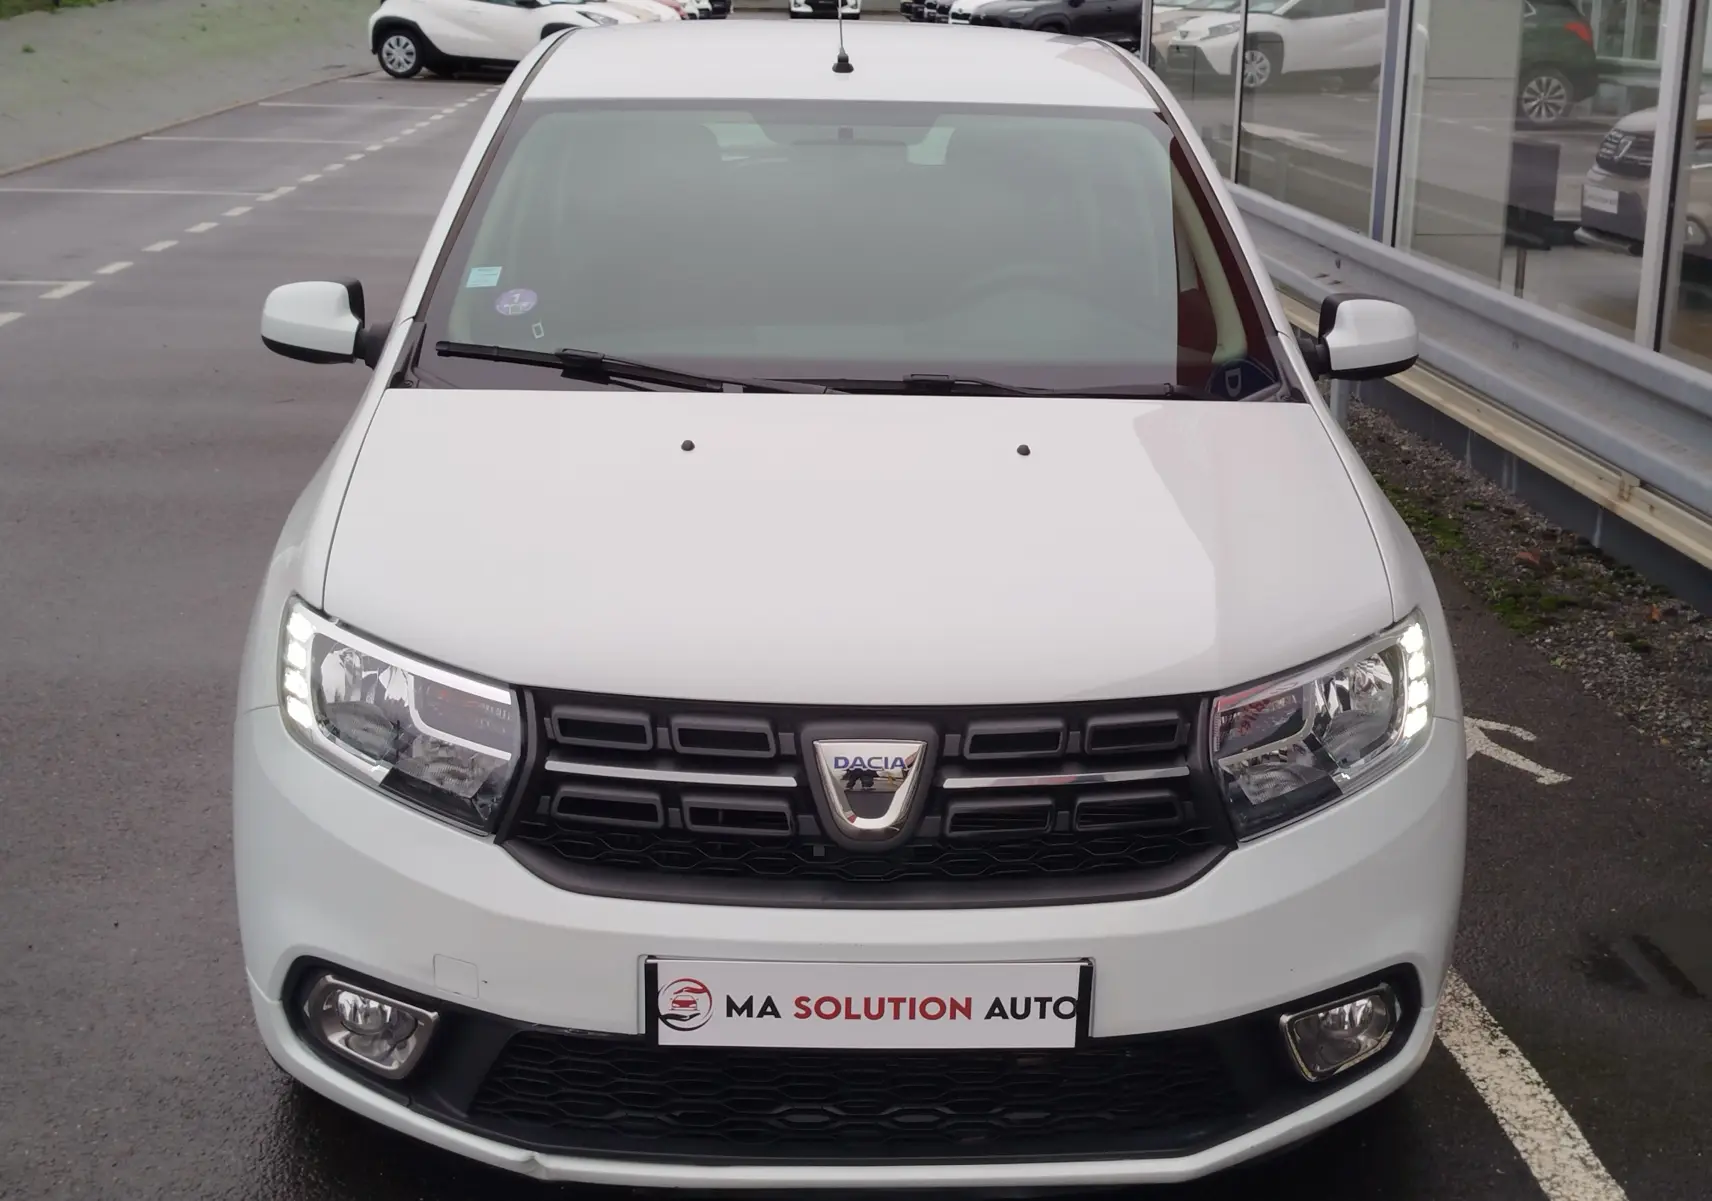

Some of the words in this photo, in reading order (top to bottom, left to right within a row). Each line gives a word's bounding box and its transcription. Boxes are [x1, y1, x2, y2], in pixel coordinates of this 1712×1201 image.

[834, 756, 907, 770] DACIA
[726, 994, 781, 1018] MA
[793, 996, 972, 1020] SOLUTION
[984, 996, 1077, 1020] AUTO
